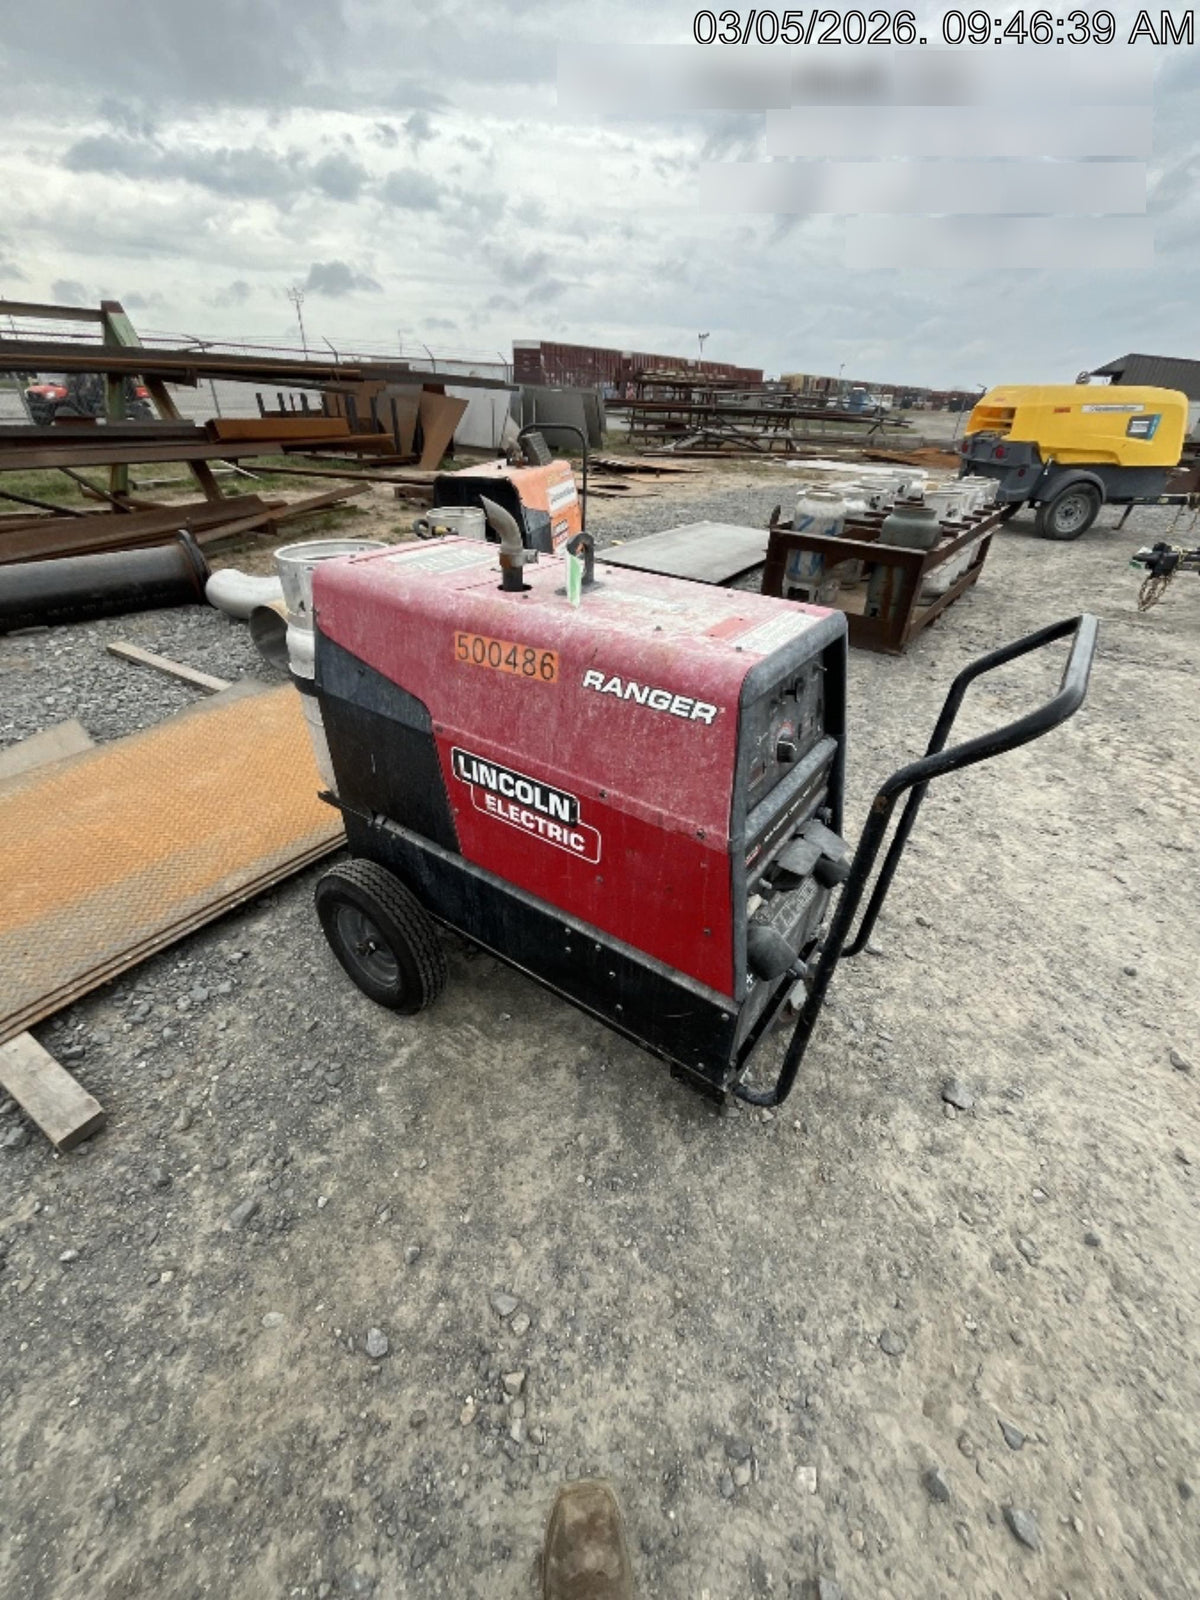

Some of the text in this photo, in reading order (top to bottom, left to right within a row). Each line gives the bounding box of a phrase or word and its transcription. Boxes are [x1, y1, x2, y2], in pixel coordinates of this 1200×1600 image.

[456, 633, 556, 681] 500486
[582, 668, 718, 725] RANGER
[457, 754, 571, 824] LINCOLN
[483, 793, 586, 853] ELECTRIC
